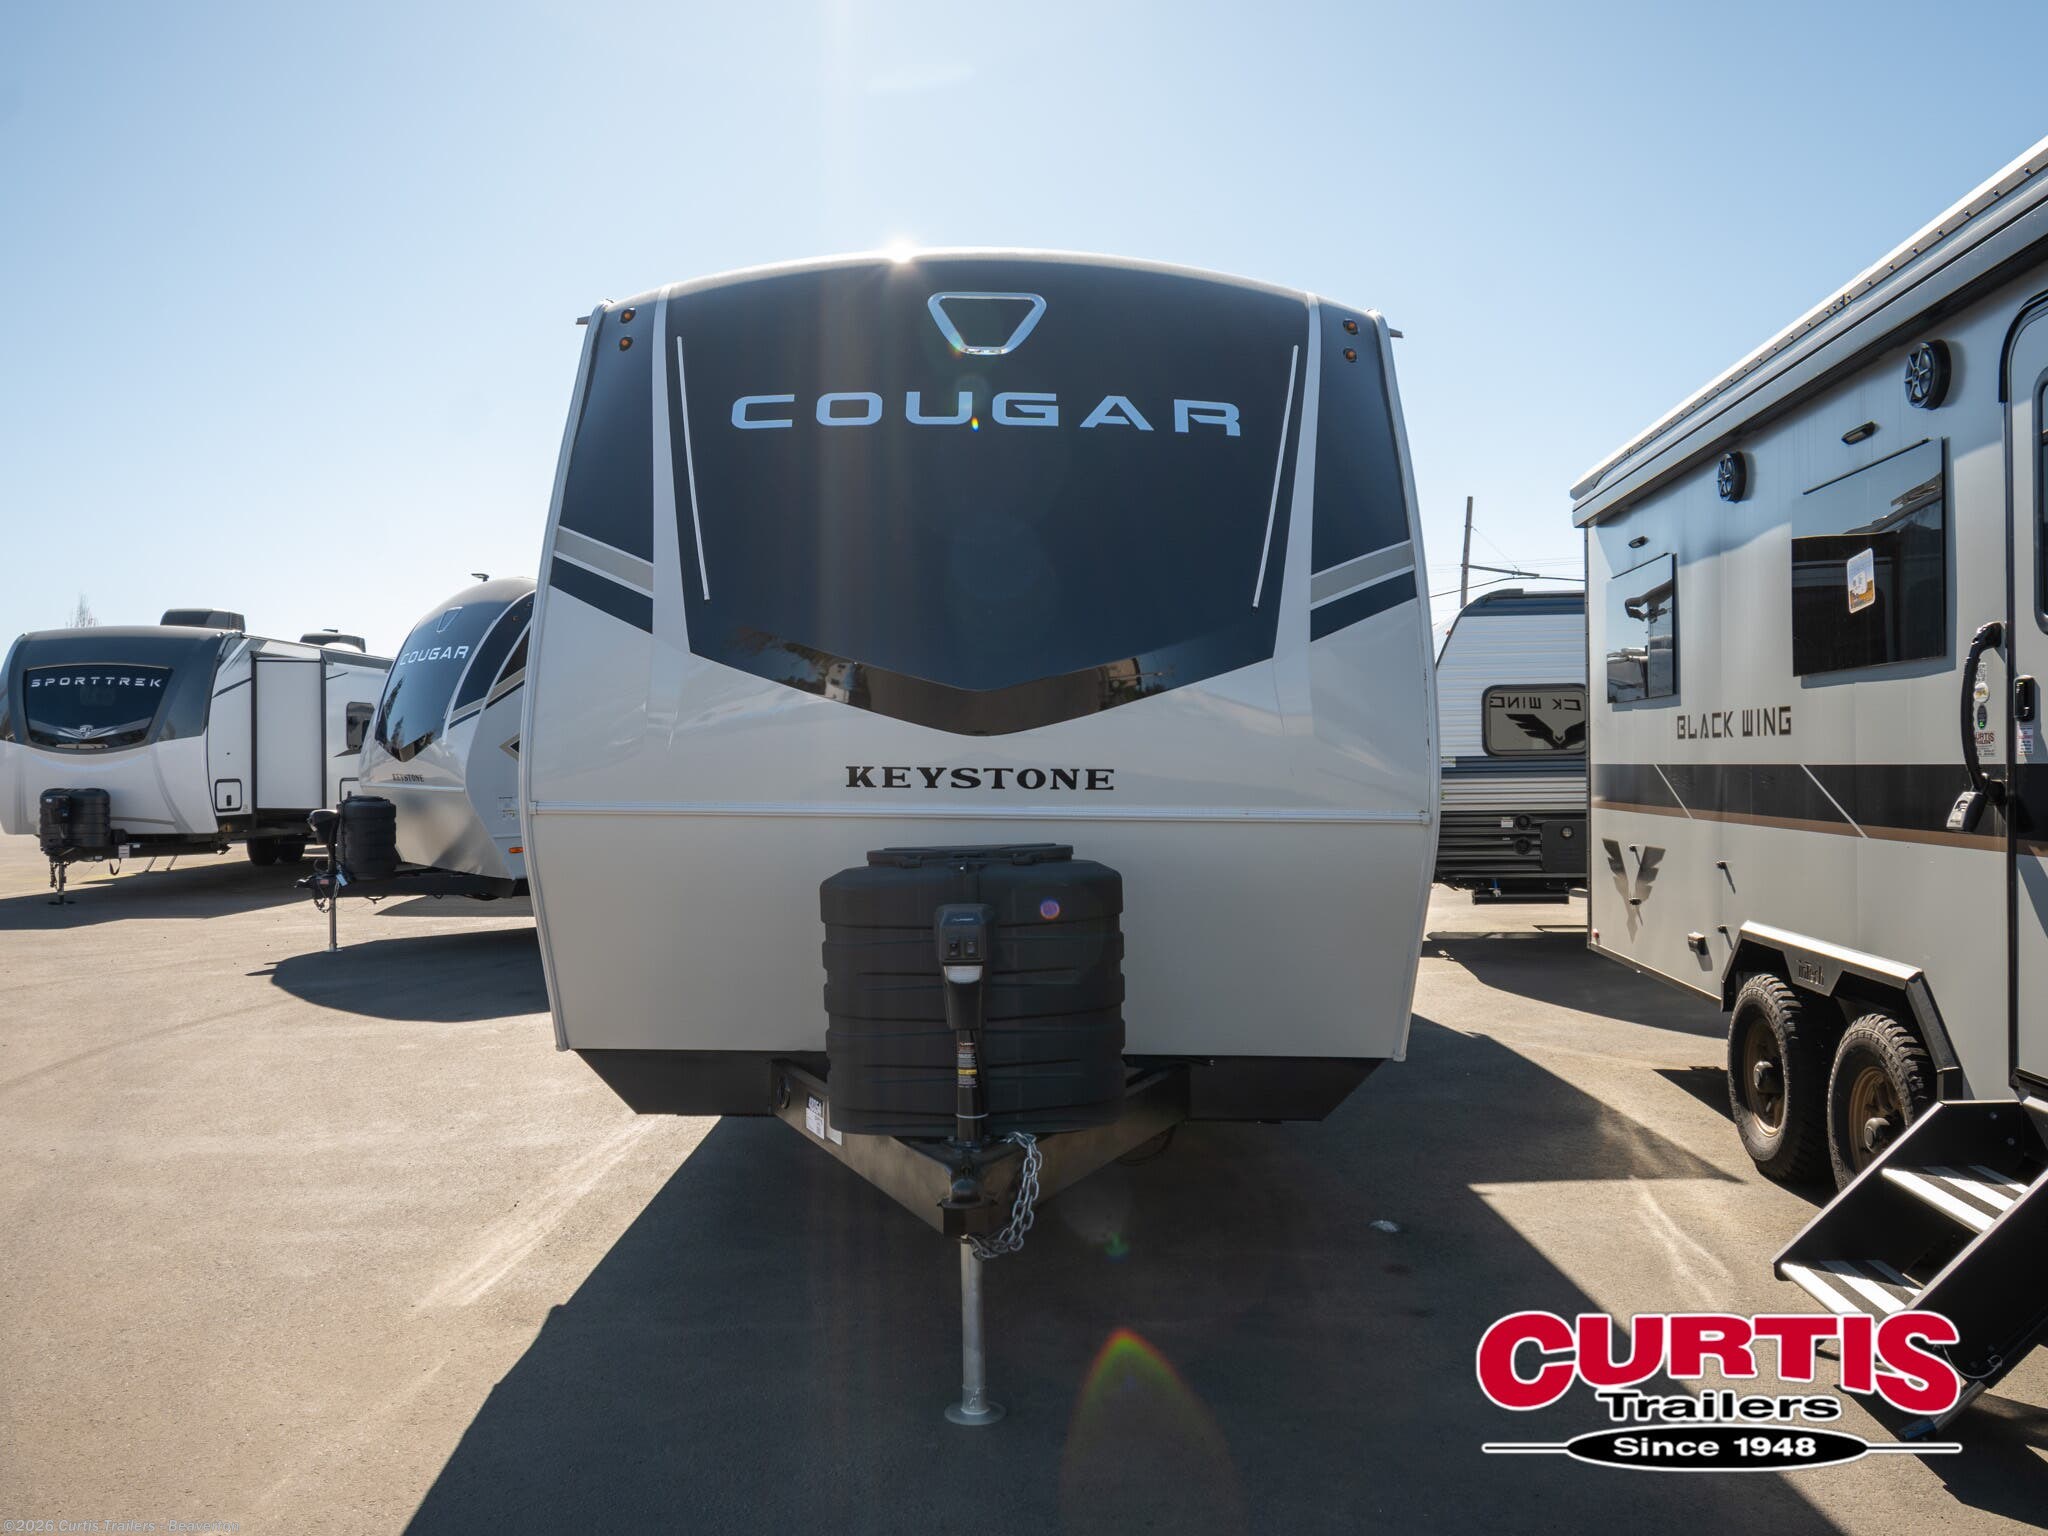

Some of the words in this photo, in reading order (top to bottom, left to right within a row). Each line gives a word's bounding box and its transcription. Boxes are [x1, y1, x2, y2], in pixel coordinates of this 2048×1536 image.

[731, 391, 1241, 437] COUGAR
[399, 645, 469, 666] COUGAR
[31, 676, 162, 688] SPORTTREK
[1677, 711, 1734, 739] BLACK
[1742, 706, 1792, 737] WING
[846, 765, 1115, 791] KEYSTONE
